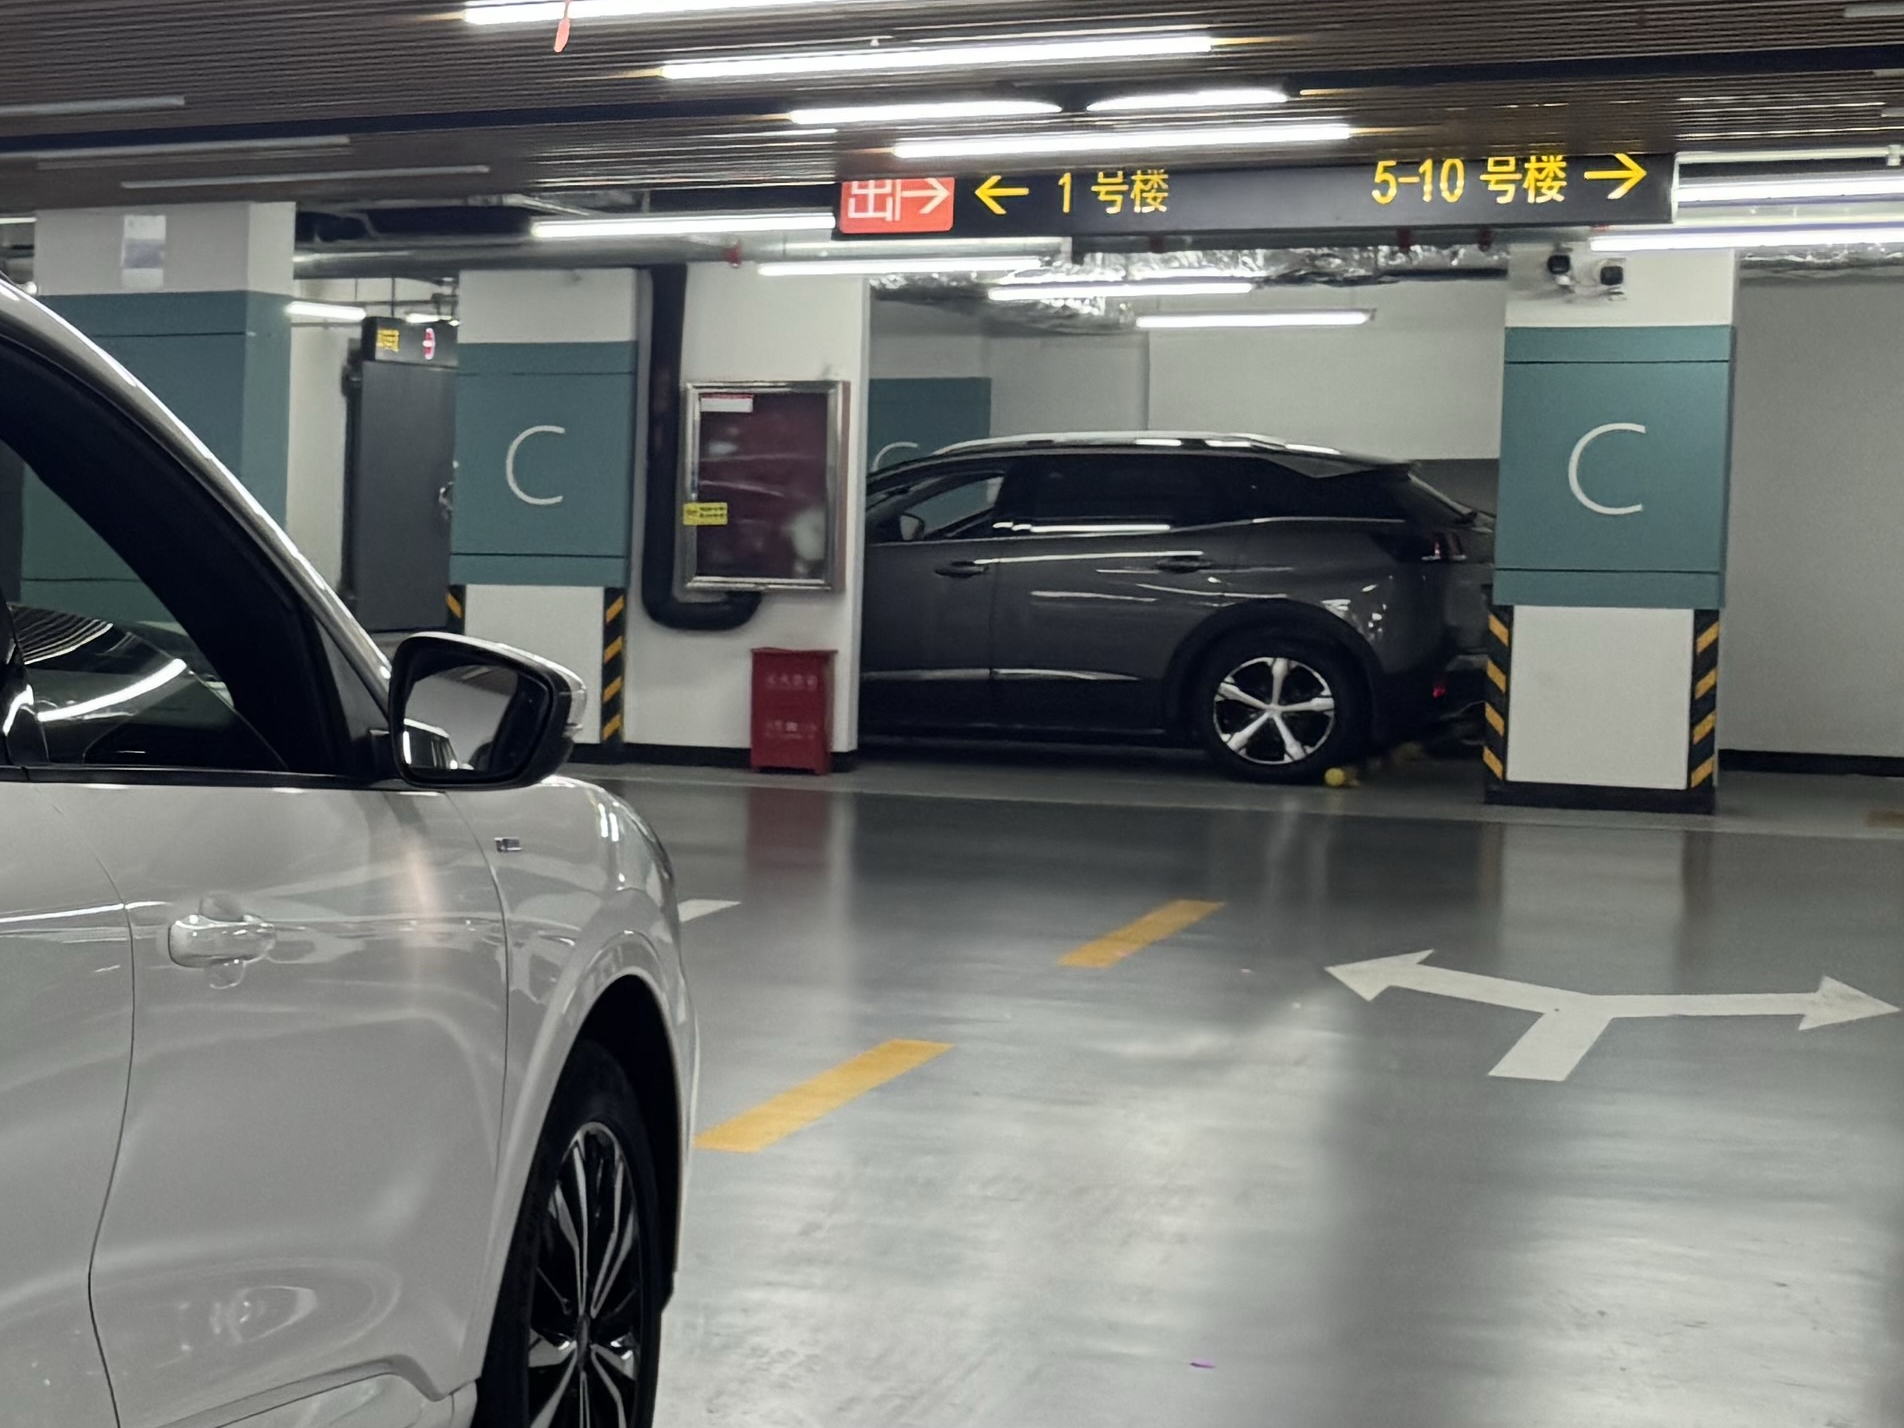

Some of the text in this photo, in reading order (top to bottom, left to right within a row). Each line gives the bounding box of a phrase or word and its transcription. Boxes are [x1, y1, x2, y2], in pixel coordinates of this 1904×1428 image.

[1058, 169, 1169, 214] 1 号楼
[1371, 154, 1567, 205] 5-10 号楼
[504, 425, 566, 506] C
[1568, 422, 1647, 516] C
